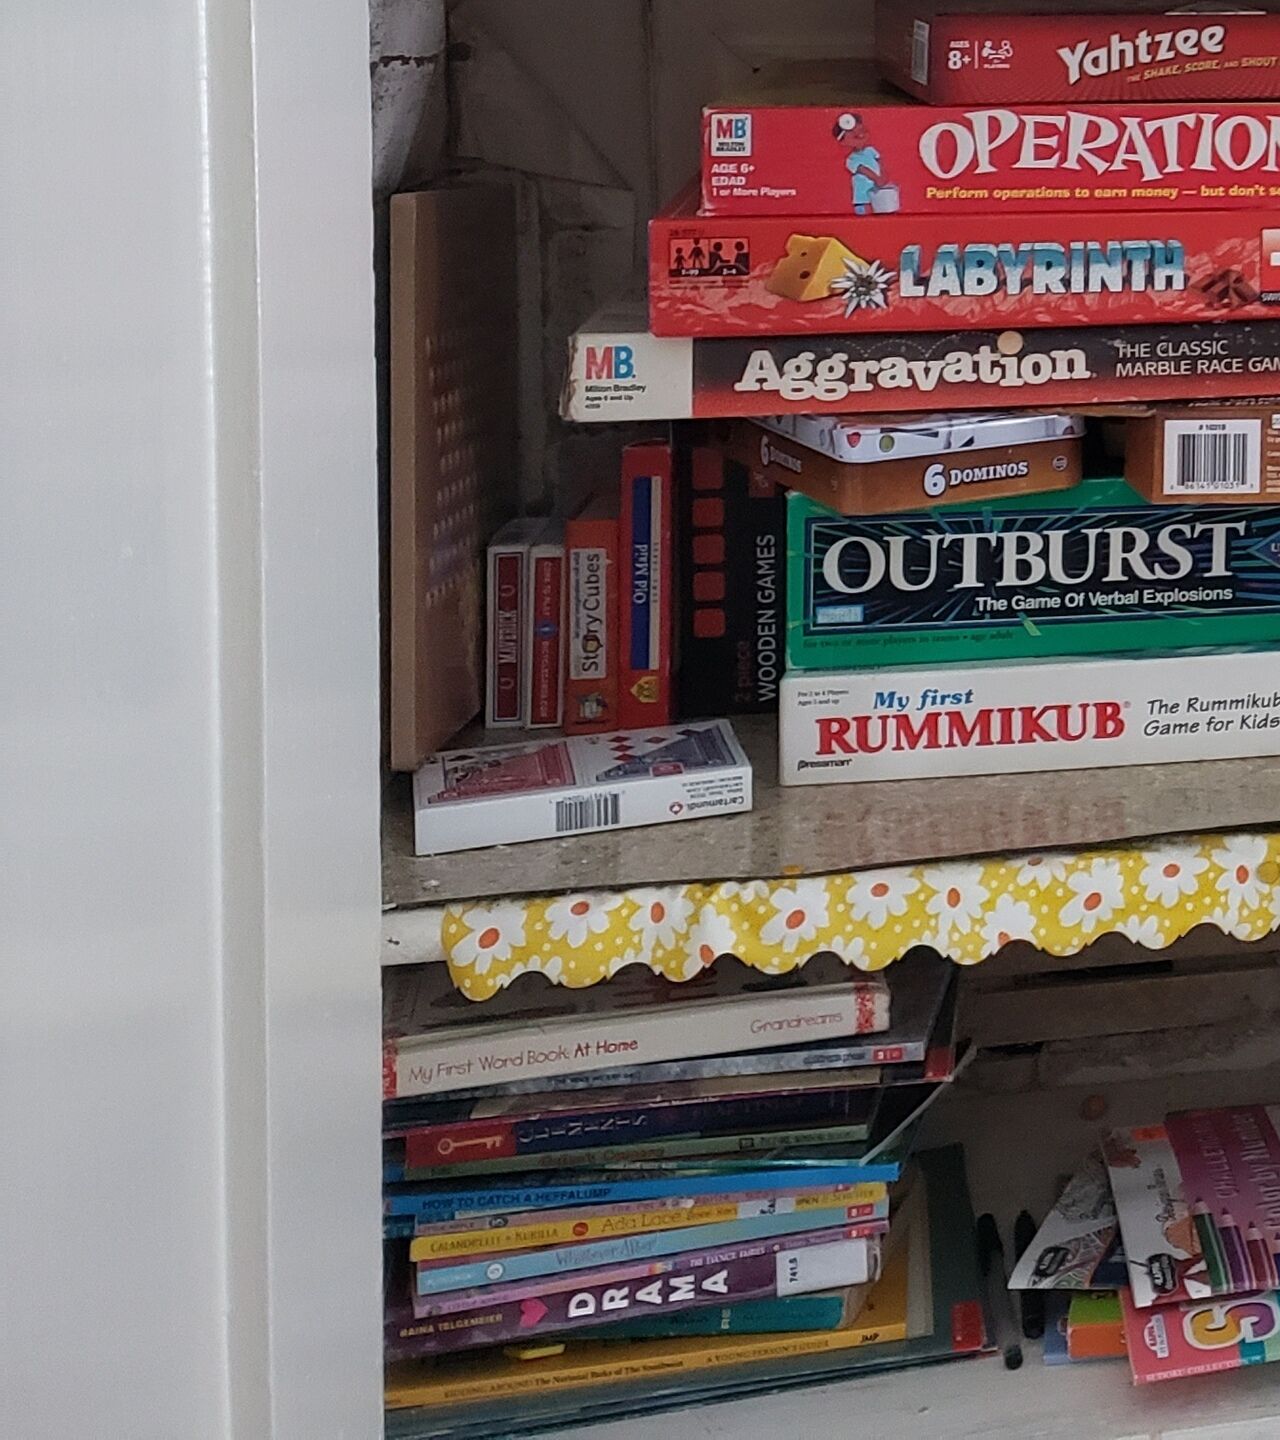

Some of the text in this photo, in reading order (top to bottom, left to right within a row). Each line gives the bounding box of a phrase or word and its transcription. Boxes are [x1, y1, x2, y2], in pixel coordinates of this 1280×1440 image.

[1056, 25, 1226, 85] Yahtzee
[716, 118, 746, 139] MB
[926, 186, 988, 199] Perform
[993, 185, 1071, 201] operations
[1075, 187, 1089, 198] to
[1094, 187, 1128, 198] earn
[1131, 187, 1178, 200] money
[1201, 185, 1226, 197] but
[1228, 184, 1266, 197] don't
[900, 239, 1185, 298] LABYRINTH
[1117, 339, 1229, 358] THE CLASSIC
[734, 330, 1092, 402] Aggravation
[1116, 359, 1194, 378] MARBLE
[1197, 358, 1244, 375] RACE
[923, 461, 1029, 497] 6 DOMINOS
[822, 520, 1247, 595] OUTBURST
[975, 586, 1234, 612] The Game Of Verbal Explosions
[756, 533, 778, 703] WOODEN GAMES
[874, 688, 974, 712] My first
[1146, 697, 1182, 716] The
[814, 701, 1126, 756] RUMMIKUB
[1142, 717, 1203, 738] Game
[1205, 714, 1235, 734] for
[797, 757, 853, 771] pressman
[687, 794, 745, 810] Cartamundi
[751, 1012, 844, 1035] Grandreams
[408, 1037, 639, 1085] My First Word At Home
[422, 1188, 612, 1210] HOW TO CATCH A HEFFALUMP
[567, 1269, 729, 1318] DRAMA
[400, 1313, 503, 1338] RAINA TELGEMEIER
